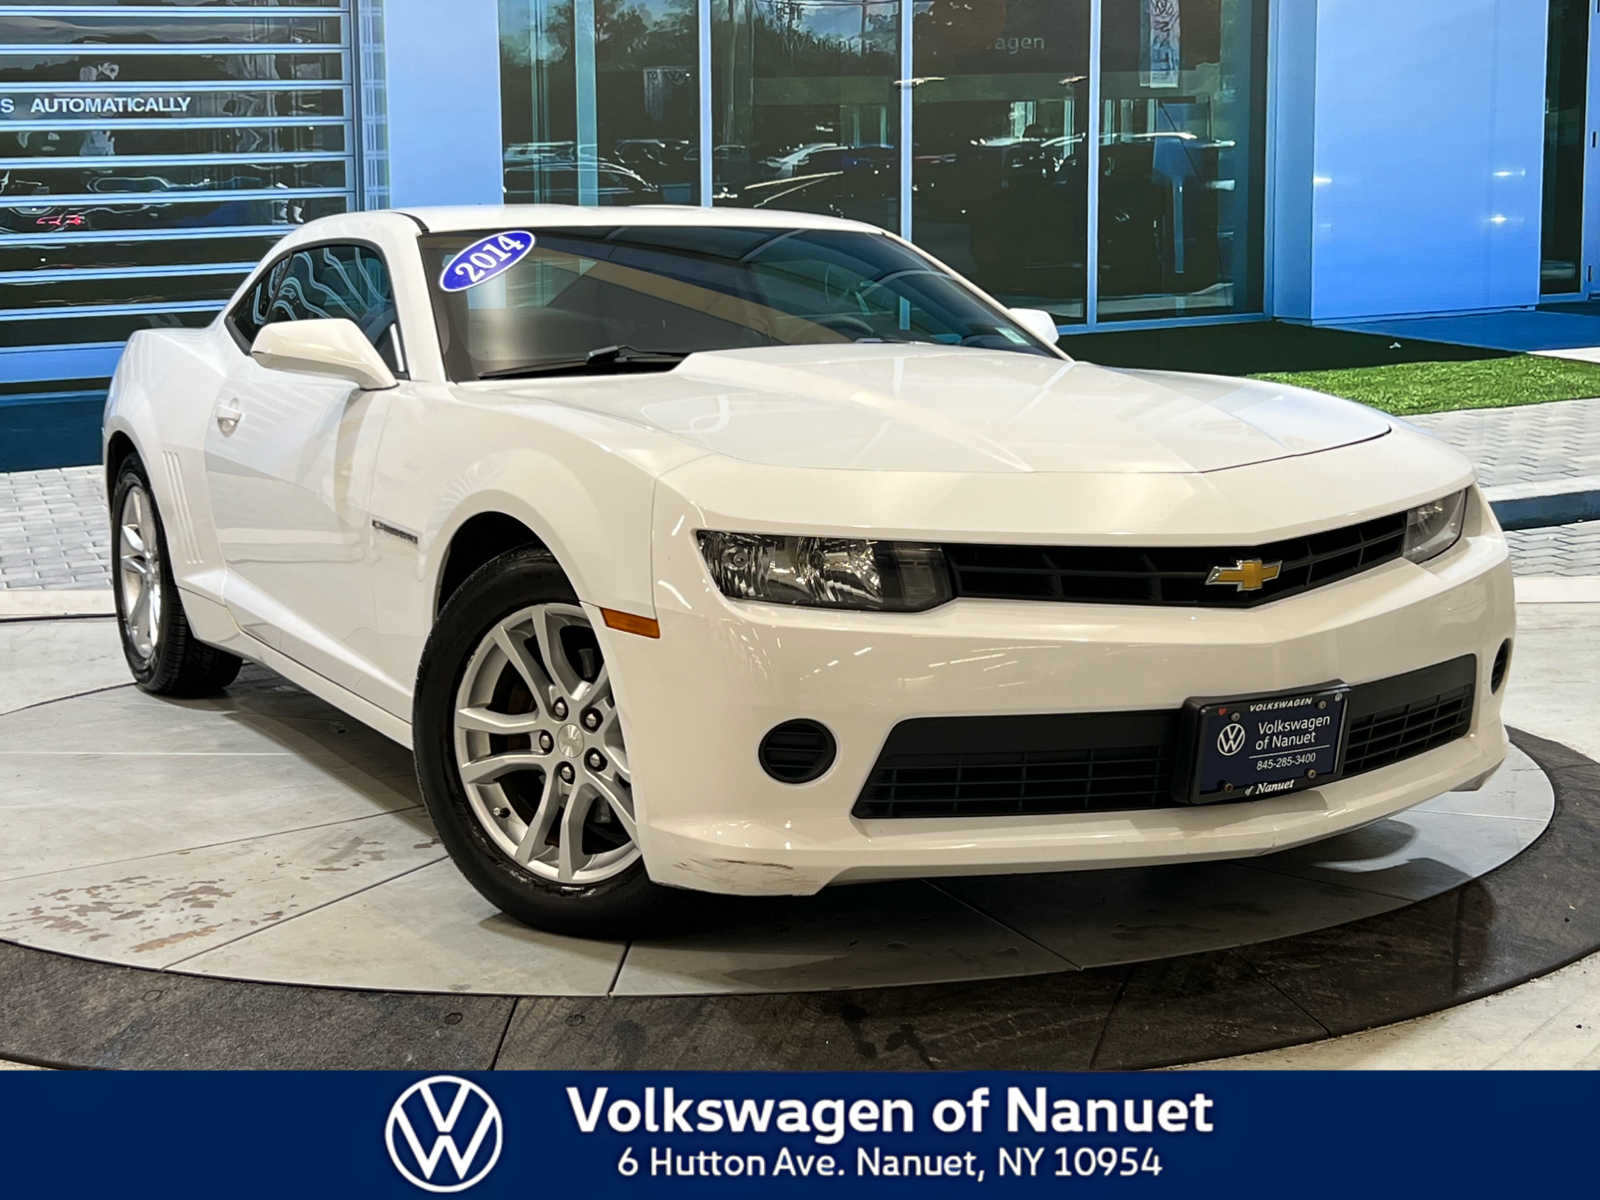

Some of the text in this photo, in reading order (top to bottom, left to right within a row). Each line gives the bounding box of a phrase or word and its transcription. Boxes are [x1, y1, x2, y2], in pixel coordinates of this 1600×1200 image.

[30, 96, 191, 113] AUTOMATICALLY
[455, 235, 525, 283] 2014
[1249, 697, 1312, 712] VOLKSWAGEN
[1258, 715, 1330, 735] Volkswagen
[1255, 731, 1316, 751] of Nanuet
[1256, 752, 1316, 771] 845-285-3400
[1255, 779, 1295, 795] Nanuet
